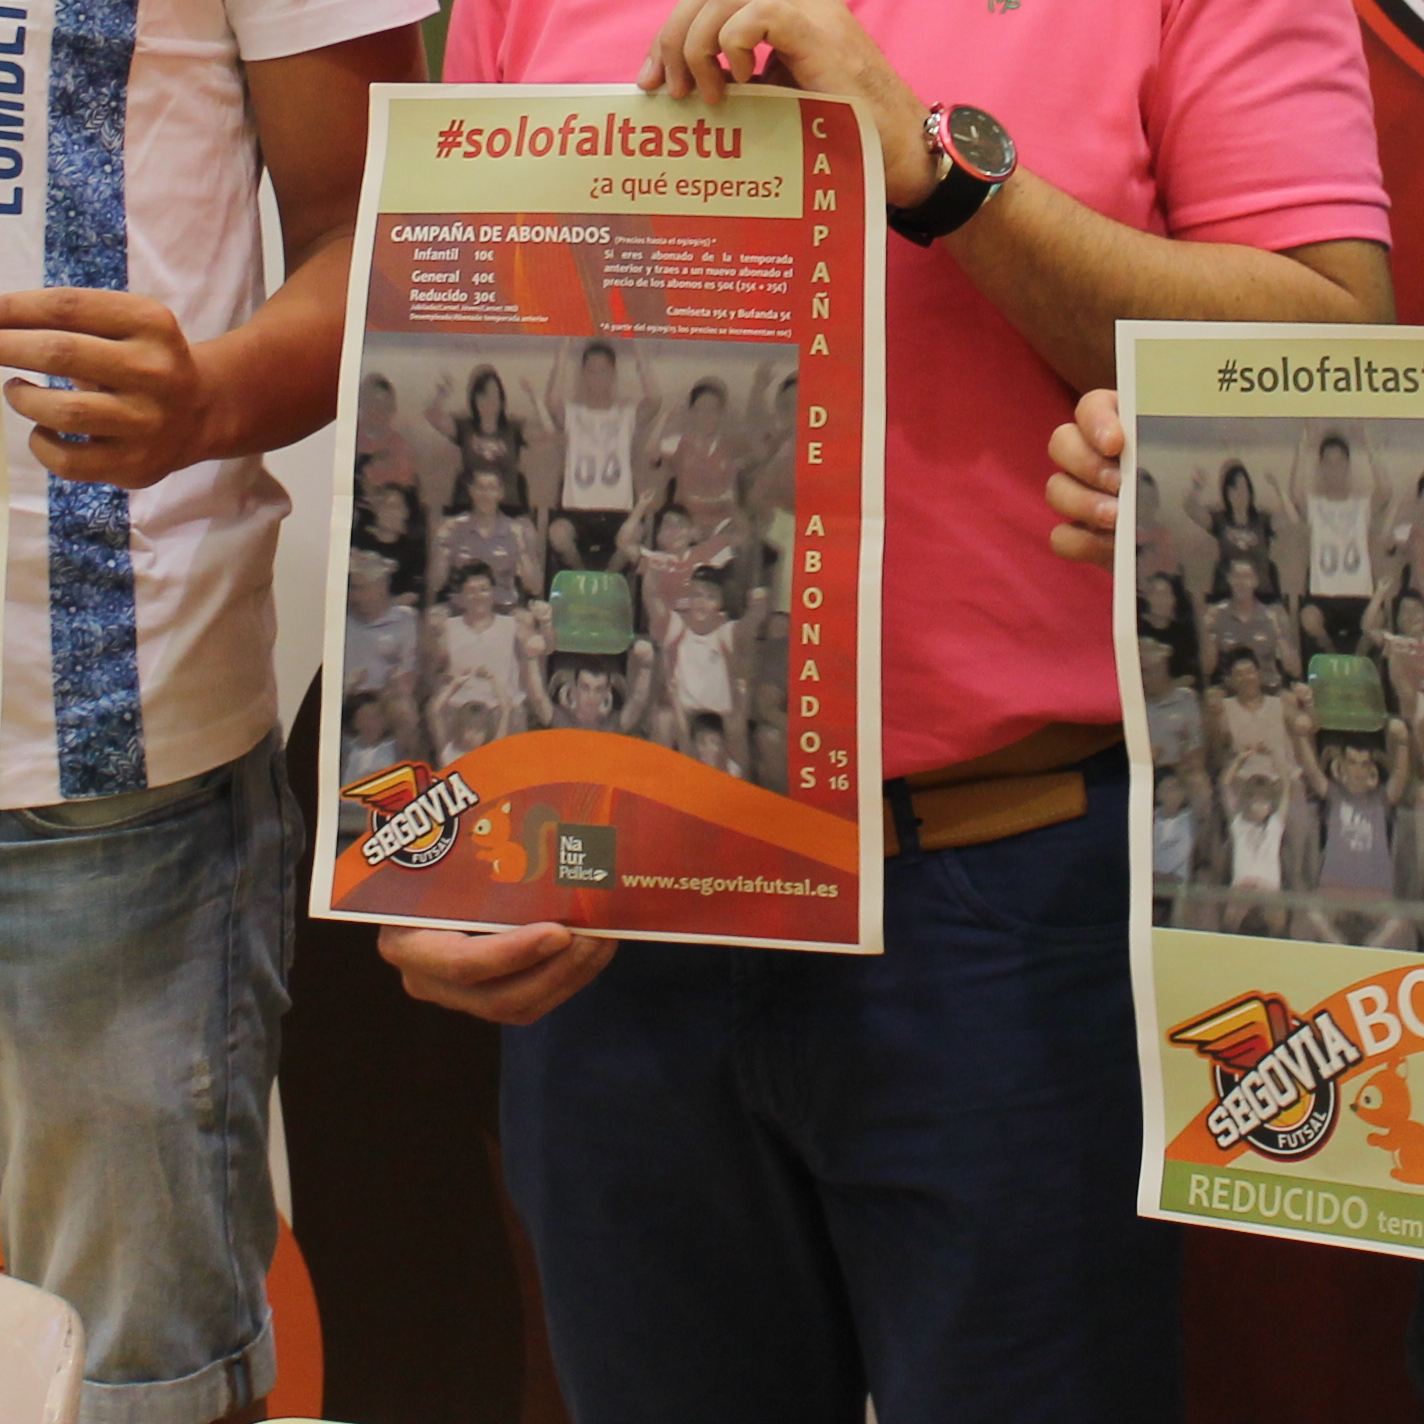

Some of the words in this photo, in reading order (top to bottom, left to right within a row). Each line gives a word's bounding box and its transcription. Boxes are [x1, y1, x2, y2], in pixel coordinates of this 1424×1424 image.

[434, 113, 743, 160] #solofaltastu
[589, 175, 614, 200] ¿a
[621, 171, 668, 203] qué
[675, 174, 783, 205] esperas?
[390, 222, 475, 243] CAMPAÑA
[479, 226, 503, 243] DE
[505, 226, 611, 244] ABONADOS
[413, 248, 459, 261] Infantil
[473, 249, 495, 262] 10€
[650, 251, 694, 262] abonado
[701, 251, 715, 262] de
[722, 252, 733, 263] la
[739, 254, 794, 265] temporada
[411, 270, 460, 284] General
[471, 272, 495, 285] 40€
[603, 263, 643, 274] anterior
[705, 268, 737, 277] nuevo
[738, 267, 782, 279] abonado
[782, 268, 793, 279] el
[602, 277, 635, 289] precio
[636, 277, 649, 288] de
[650, 277, 665, 288] los
[666, 278, 702, 289] abonos
[409, 289, 468, 303] Reducido
[473, 291, 496, 305] 30€
[666, 306, 711, 318] Camiseta
[828, 749, 848, 768] 15
[828, 773, 849, 791] 16
[362, 772, 479, 866] SEGOVIA
[411, 836, 453, 864] FUTSAL
[560, 835, 583, 852] Na
[559, 851, 587, 866] tur
[621, 871, 839, 899] www.segoviafutsal.es
[1206, 1011, 1362, 1148] SEGOVIA
[1276, 1110, 1328, 1150] FUTSAL
[1186, 1172, 1369, 1230] REDUCIDO
